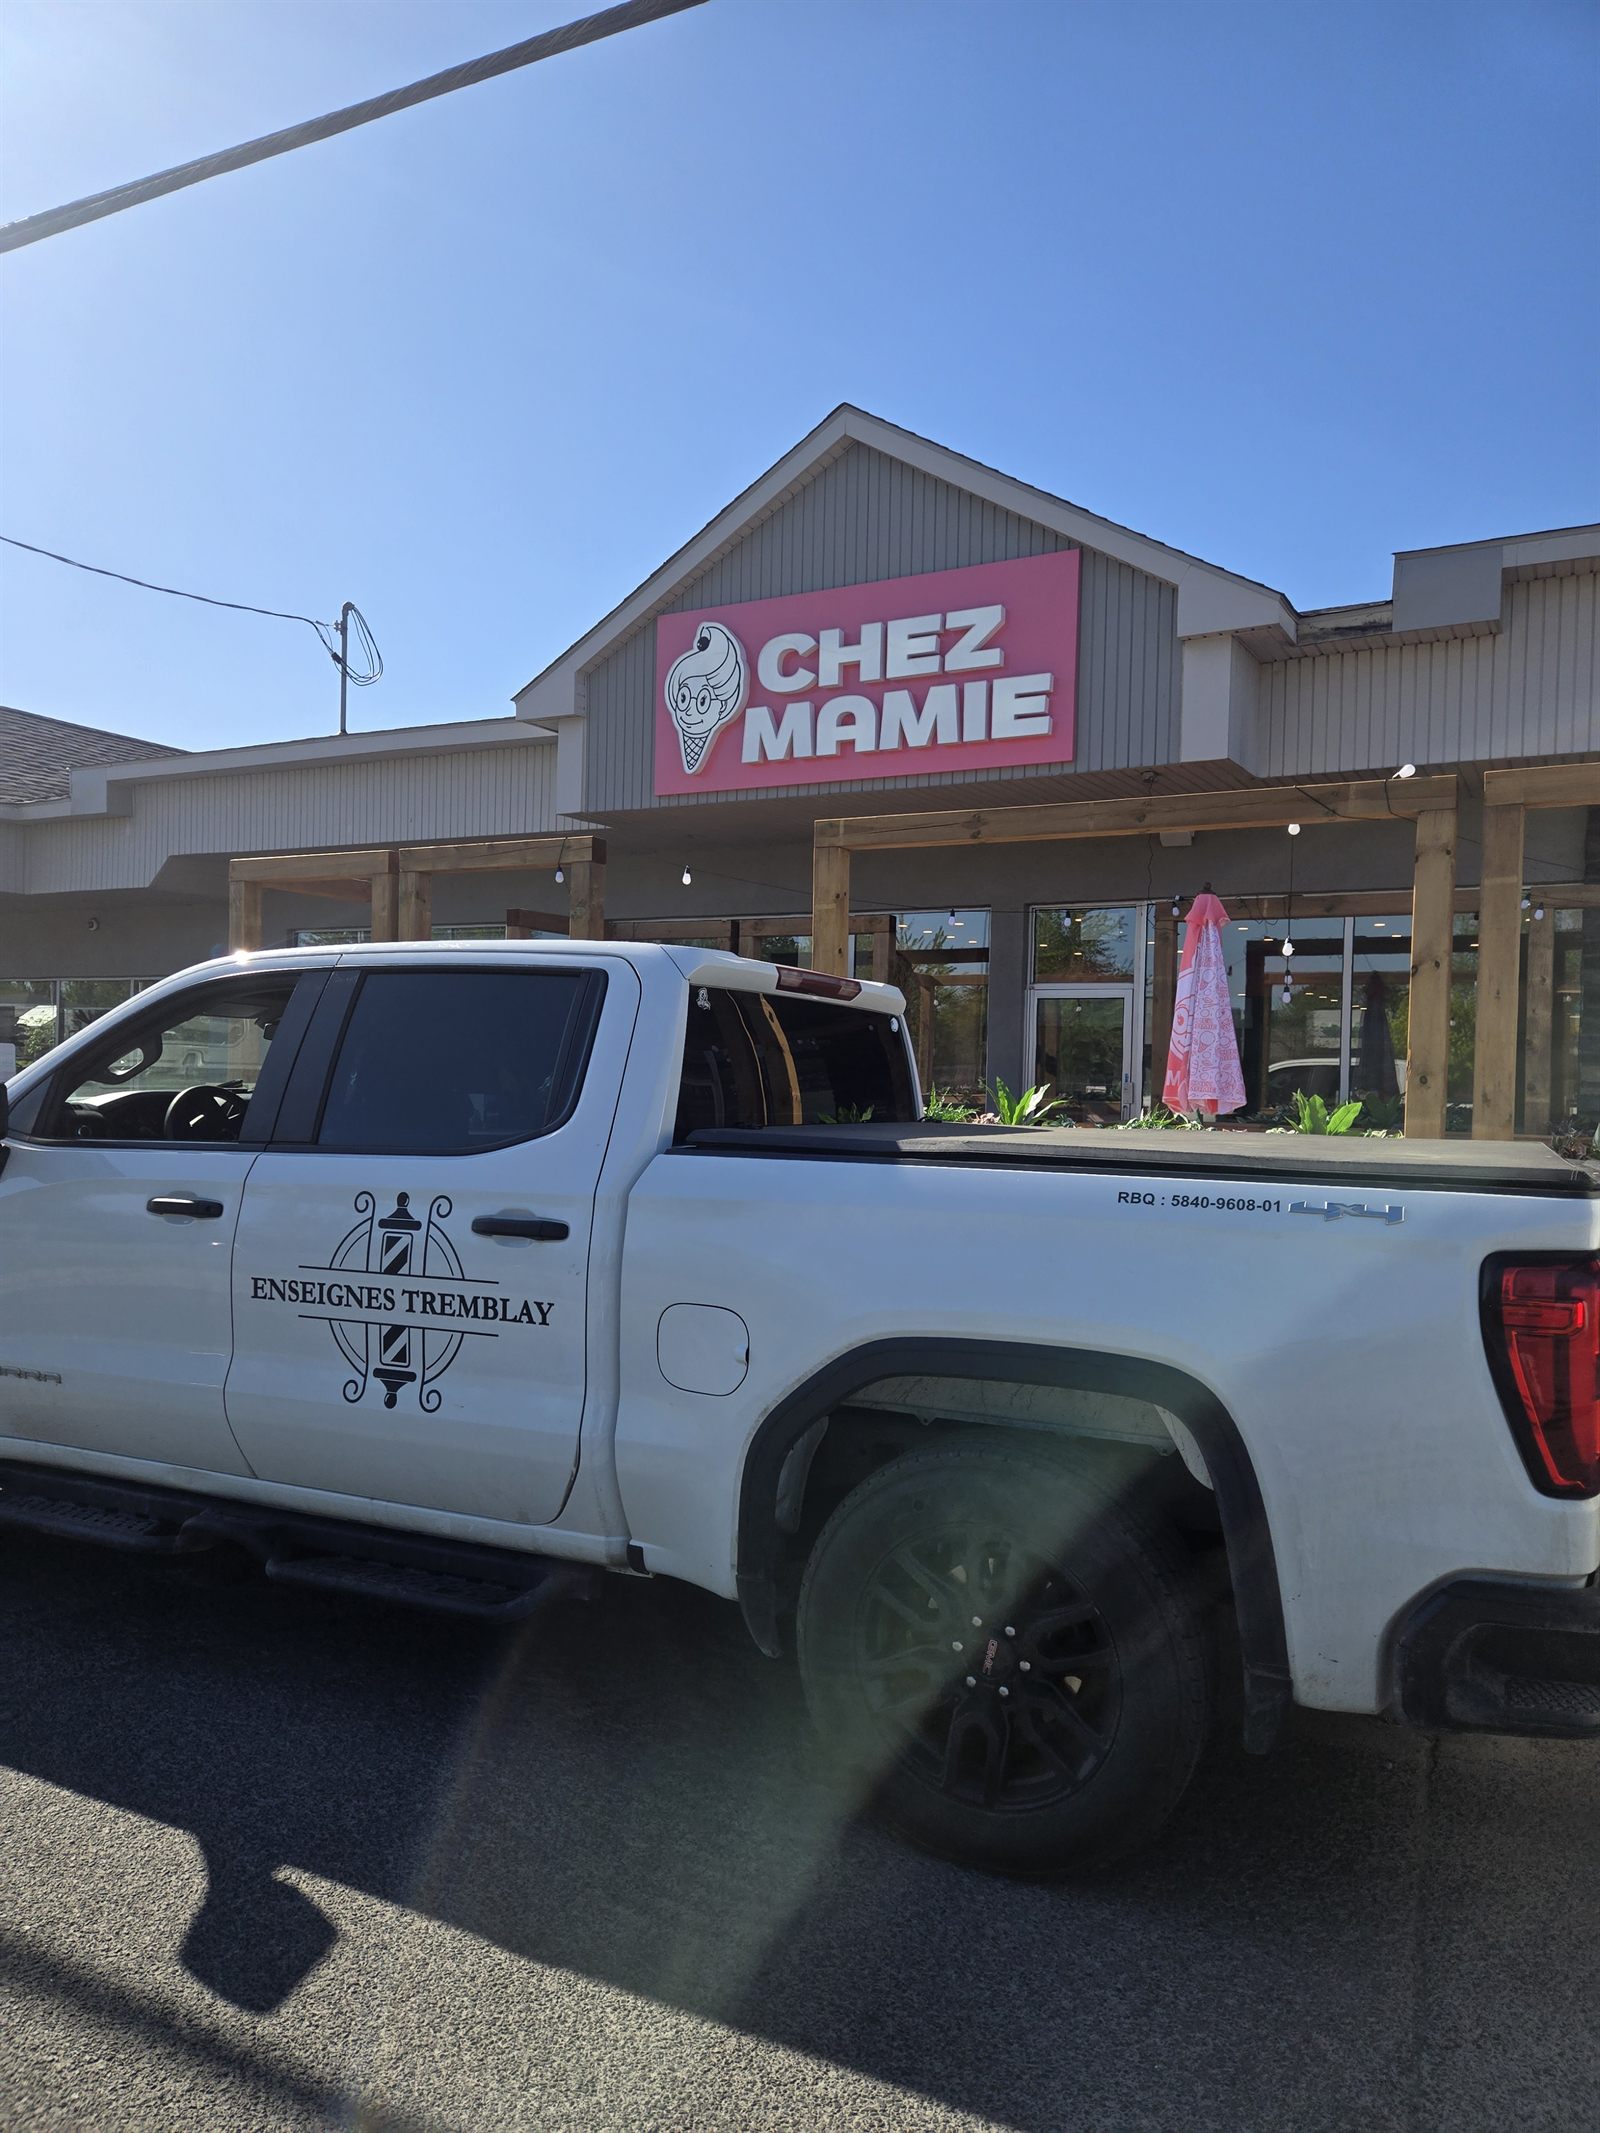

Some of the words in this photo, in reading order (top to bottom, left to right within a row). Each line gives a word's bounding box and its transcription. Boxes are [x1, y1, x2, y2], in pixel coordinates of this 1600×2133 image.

[756, 604, 1006, 694] CHEZ
[741, 672, 1055, 764] MAMIE
[1117, 1191, 1156, 1207] RBQ
[1170, 1194, 1282, 1213] 5840-9608-01
[250, 1277, 396, 1311] ENSEIGNES
[401, 1288, 555, 1327] TREMBLAY
